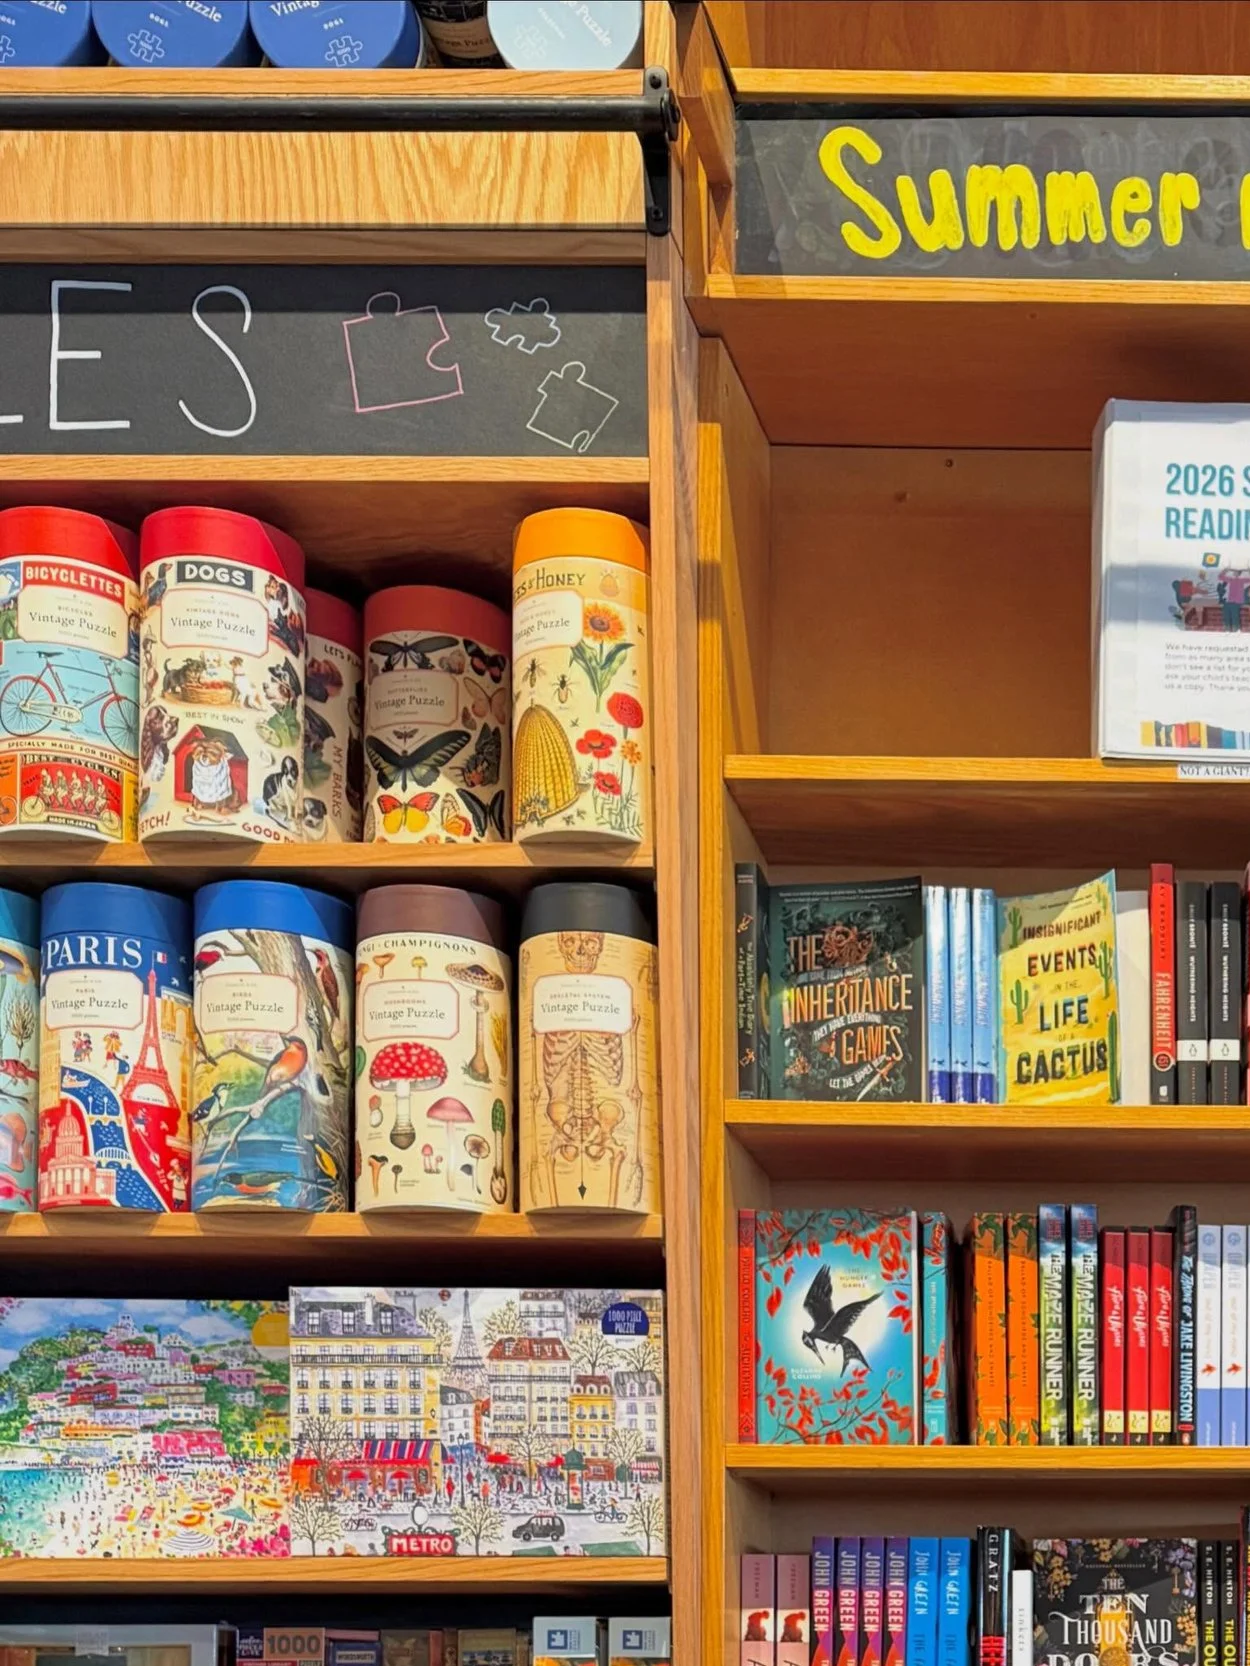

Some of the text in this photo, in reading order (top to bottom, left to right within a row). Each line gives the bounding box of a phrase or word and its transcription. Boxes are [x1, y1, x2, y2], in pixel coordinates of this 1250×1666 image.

[817, 125, 1200, 260] Summer
[1166, 463, 1235, 496] 2026
[25, 567, 122, 598] BICYCLETTES
[185, 564, 246, 586] DOGS
[30, 612, 117, 638] Vintage Puzzle
[170, 617, 255, 636] Vintage Puzzle
[1180, 765, 1200, 776] NOT
[1203, 766, 1211, 776] A
[1212, 766, 1250, 777] GIANT?
[1023, 911, 1101, 940] INSIGNIFICANT
[46, 936, 142, 970] PARIS
[384, 938, 477, 956] CHAMPIGNONS
[788, 936, 822, 973] THE
[1027, 942, 1097, 977] EVENTS
[52, 997, 128, 1011] Vintage Puzzle
[787, 974, 913, 1023] INHERITANCE
[1038, 996, 1089, 1032] LIFE
[842, 1026, 903, 1066] GAMES
[1015, 1039, 1107, 1086] CACTUS
[391, 1536, 453, 1554] METRO
[1102, 1578, 1126, 1590] THE
[1080, 1593, 1149, 1616] TEN
[1060, 1613, 1172, 1647] THOUSAND
